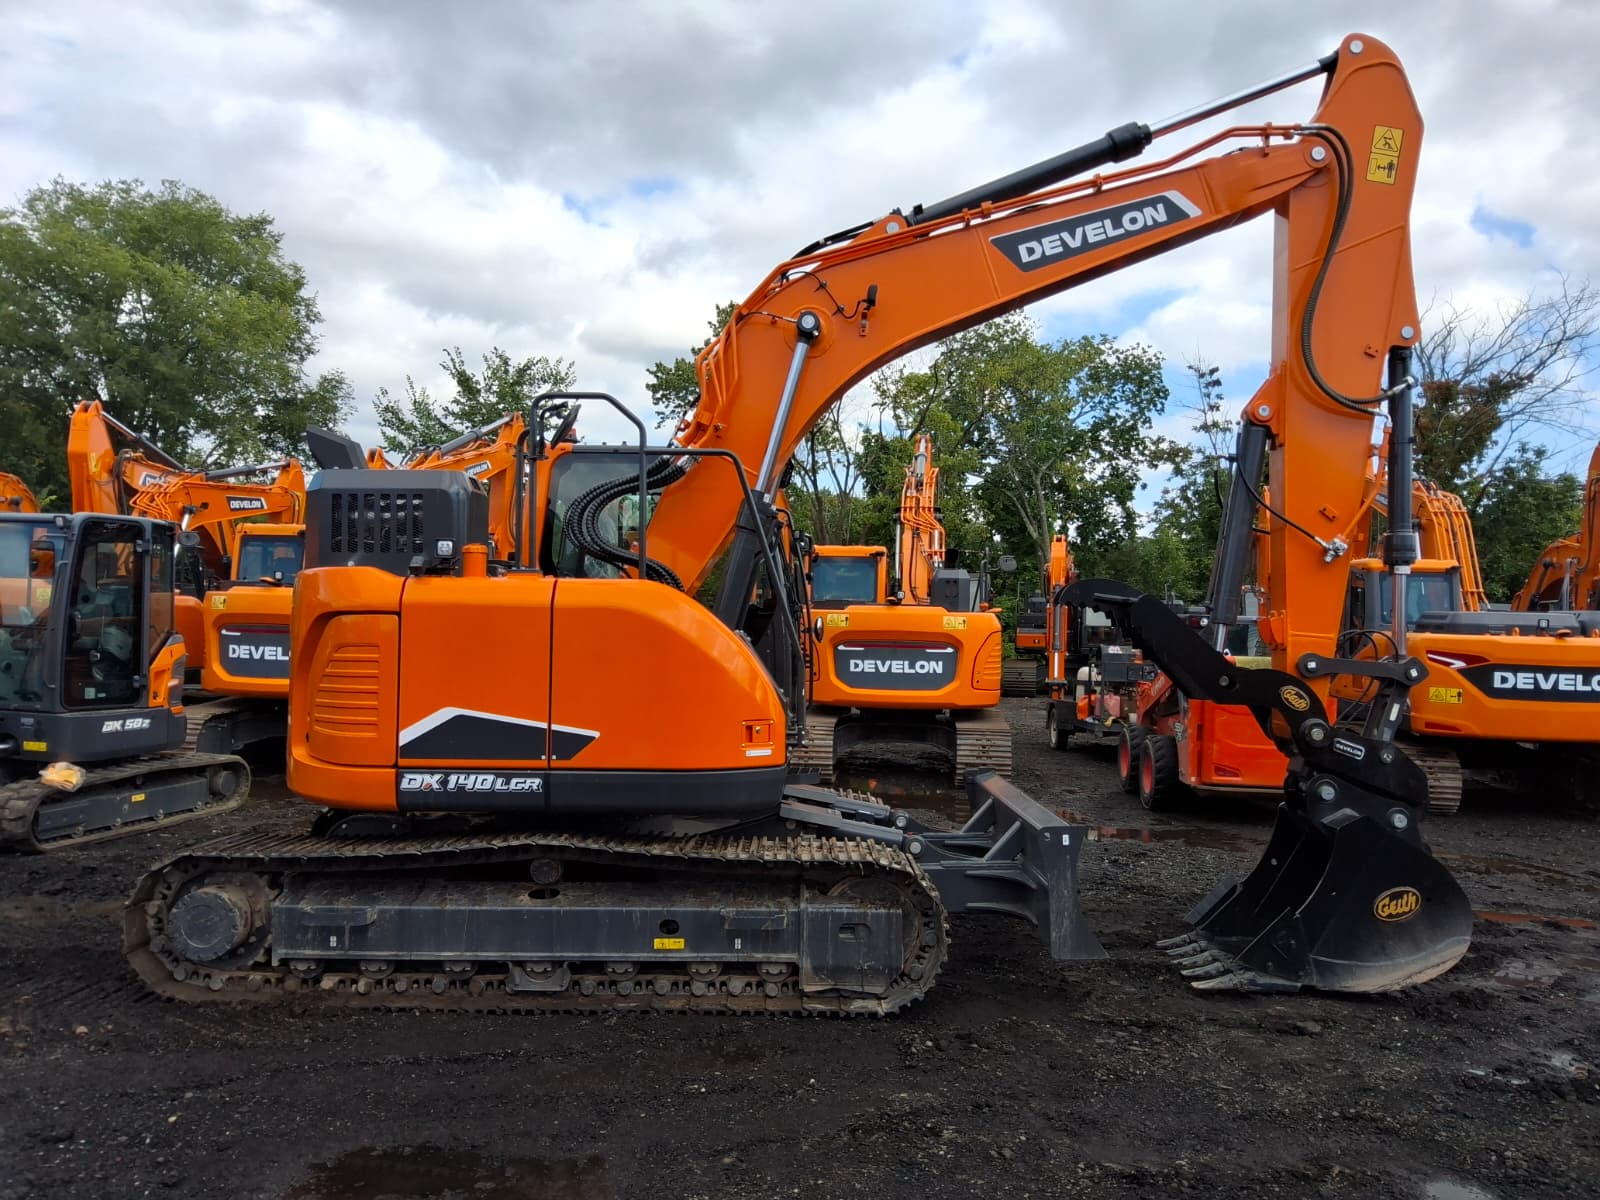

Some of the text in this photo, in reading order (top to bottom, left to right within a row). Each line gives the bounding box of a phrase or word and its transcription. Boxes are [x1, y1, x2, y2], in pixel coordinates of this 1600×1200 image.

[1018, 203, 1168, 263] DEVELON
[230, 500, 261, 509] DEVELON
[228, 644, 292, 661] DEVEL
[849, 659, 943, 674] DEVELON
[400, 773, 445, 791] DX
